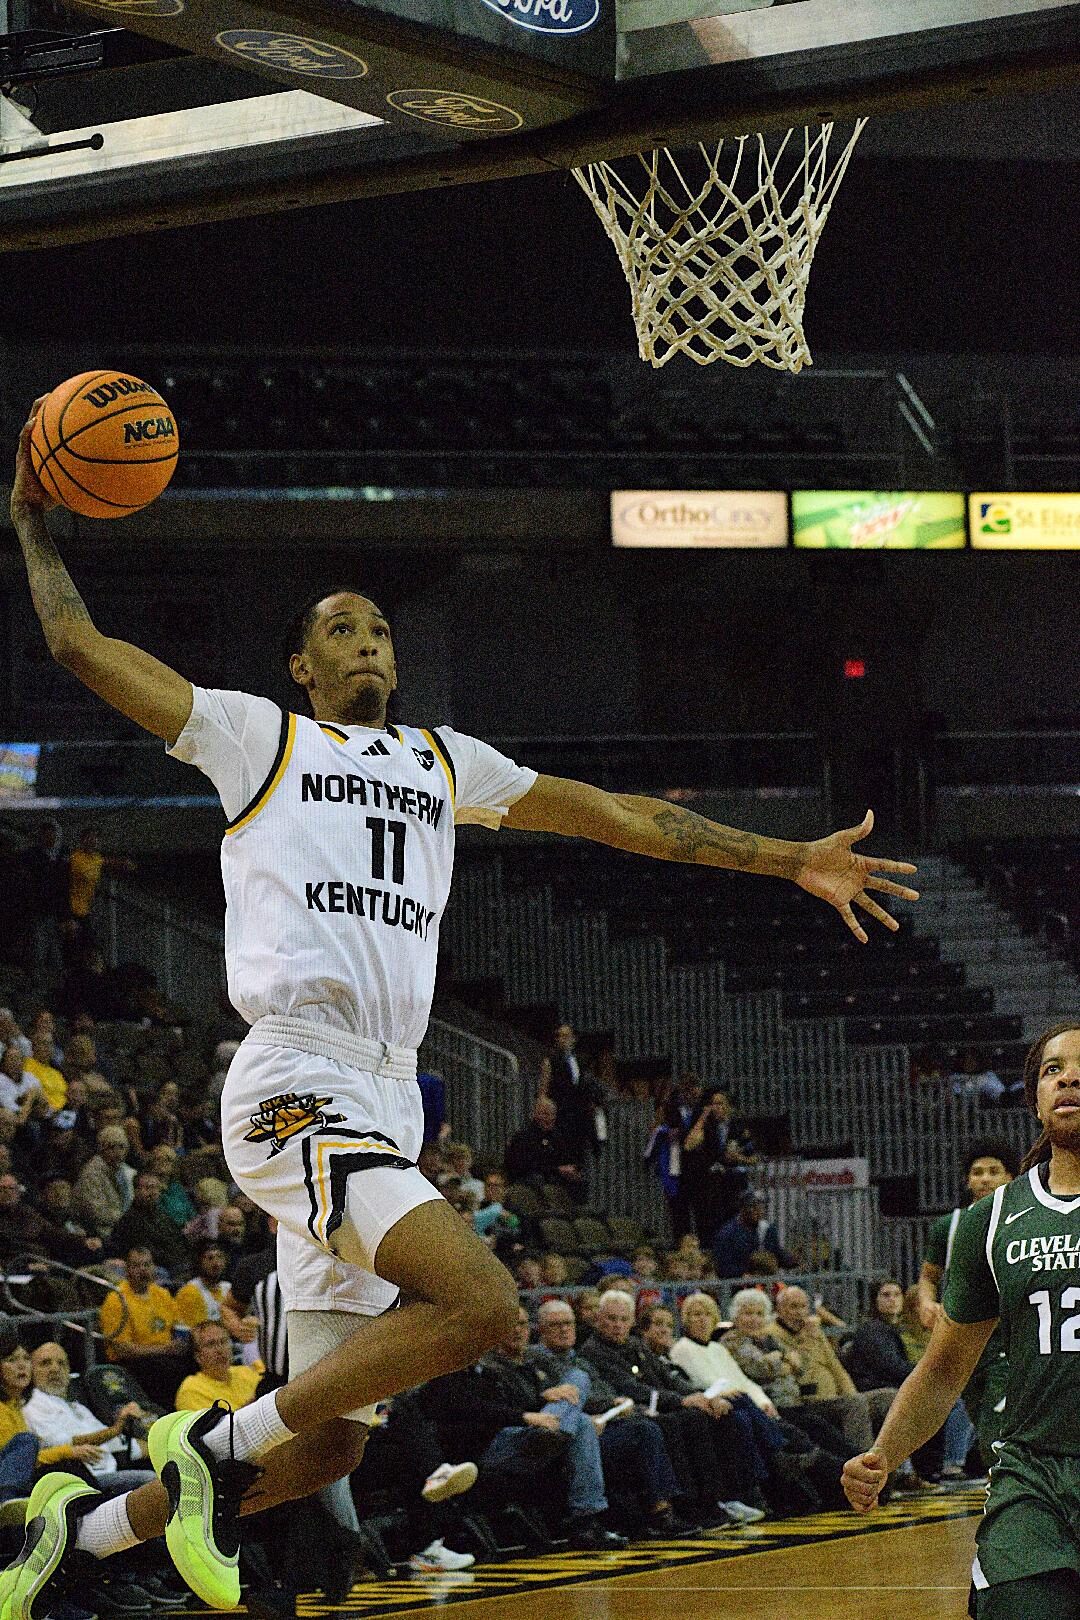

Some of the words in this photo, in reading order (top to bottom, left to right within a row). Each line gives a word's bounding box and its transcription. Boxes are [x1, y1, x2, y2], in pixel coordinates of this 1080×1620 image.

[234, 39, 346, 70] Ford
[403, 98, 501, 124] Ford
[124, 417, 175, 444] NCAA
[302, 773, 444, 831] NORTHERN
[366, 816, 406, 885] 11
[305, 881, 436, 942] KENTUCKY
[1031, 1252, 1080, 1272] STAT
[1029, 1287, 1080, 1355] 12
